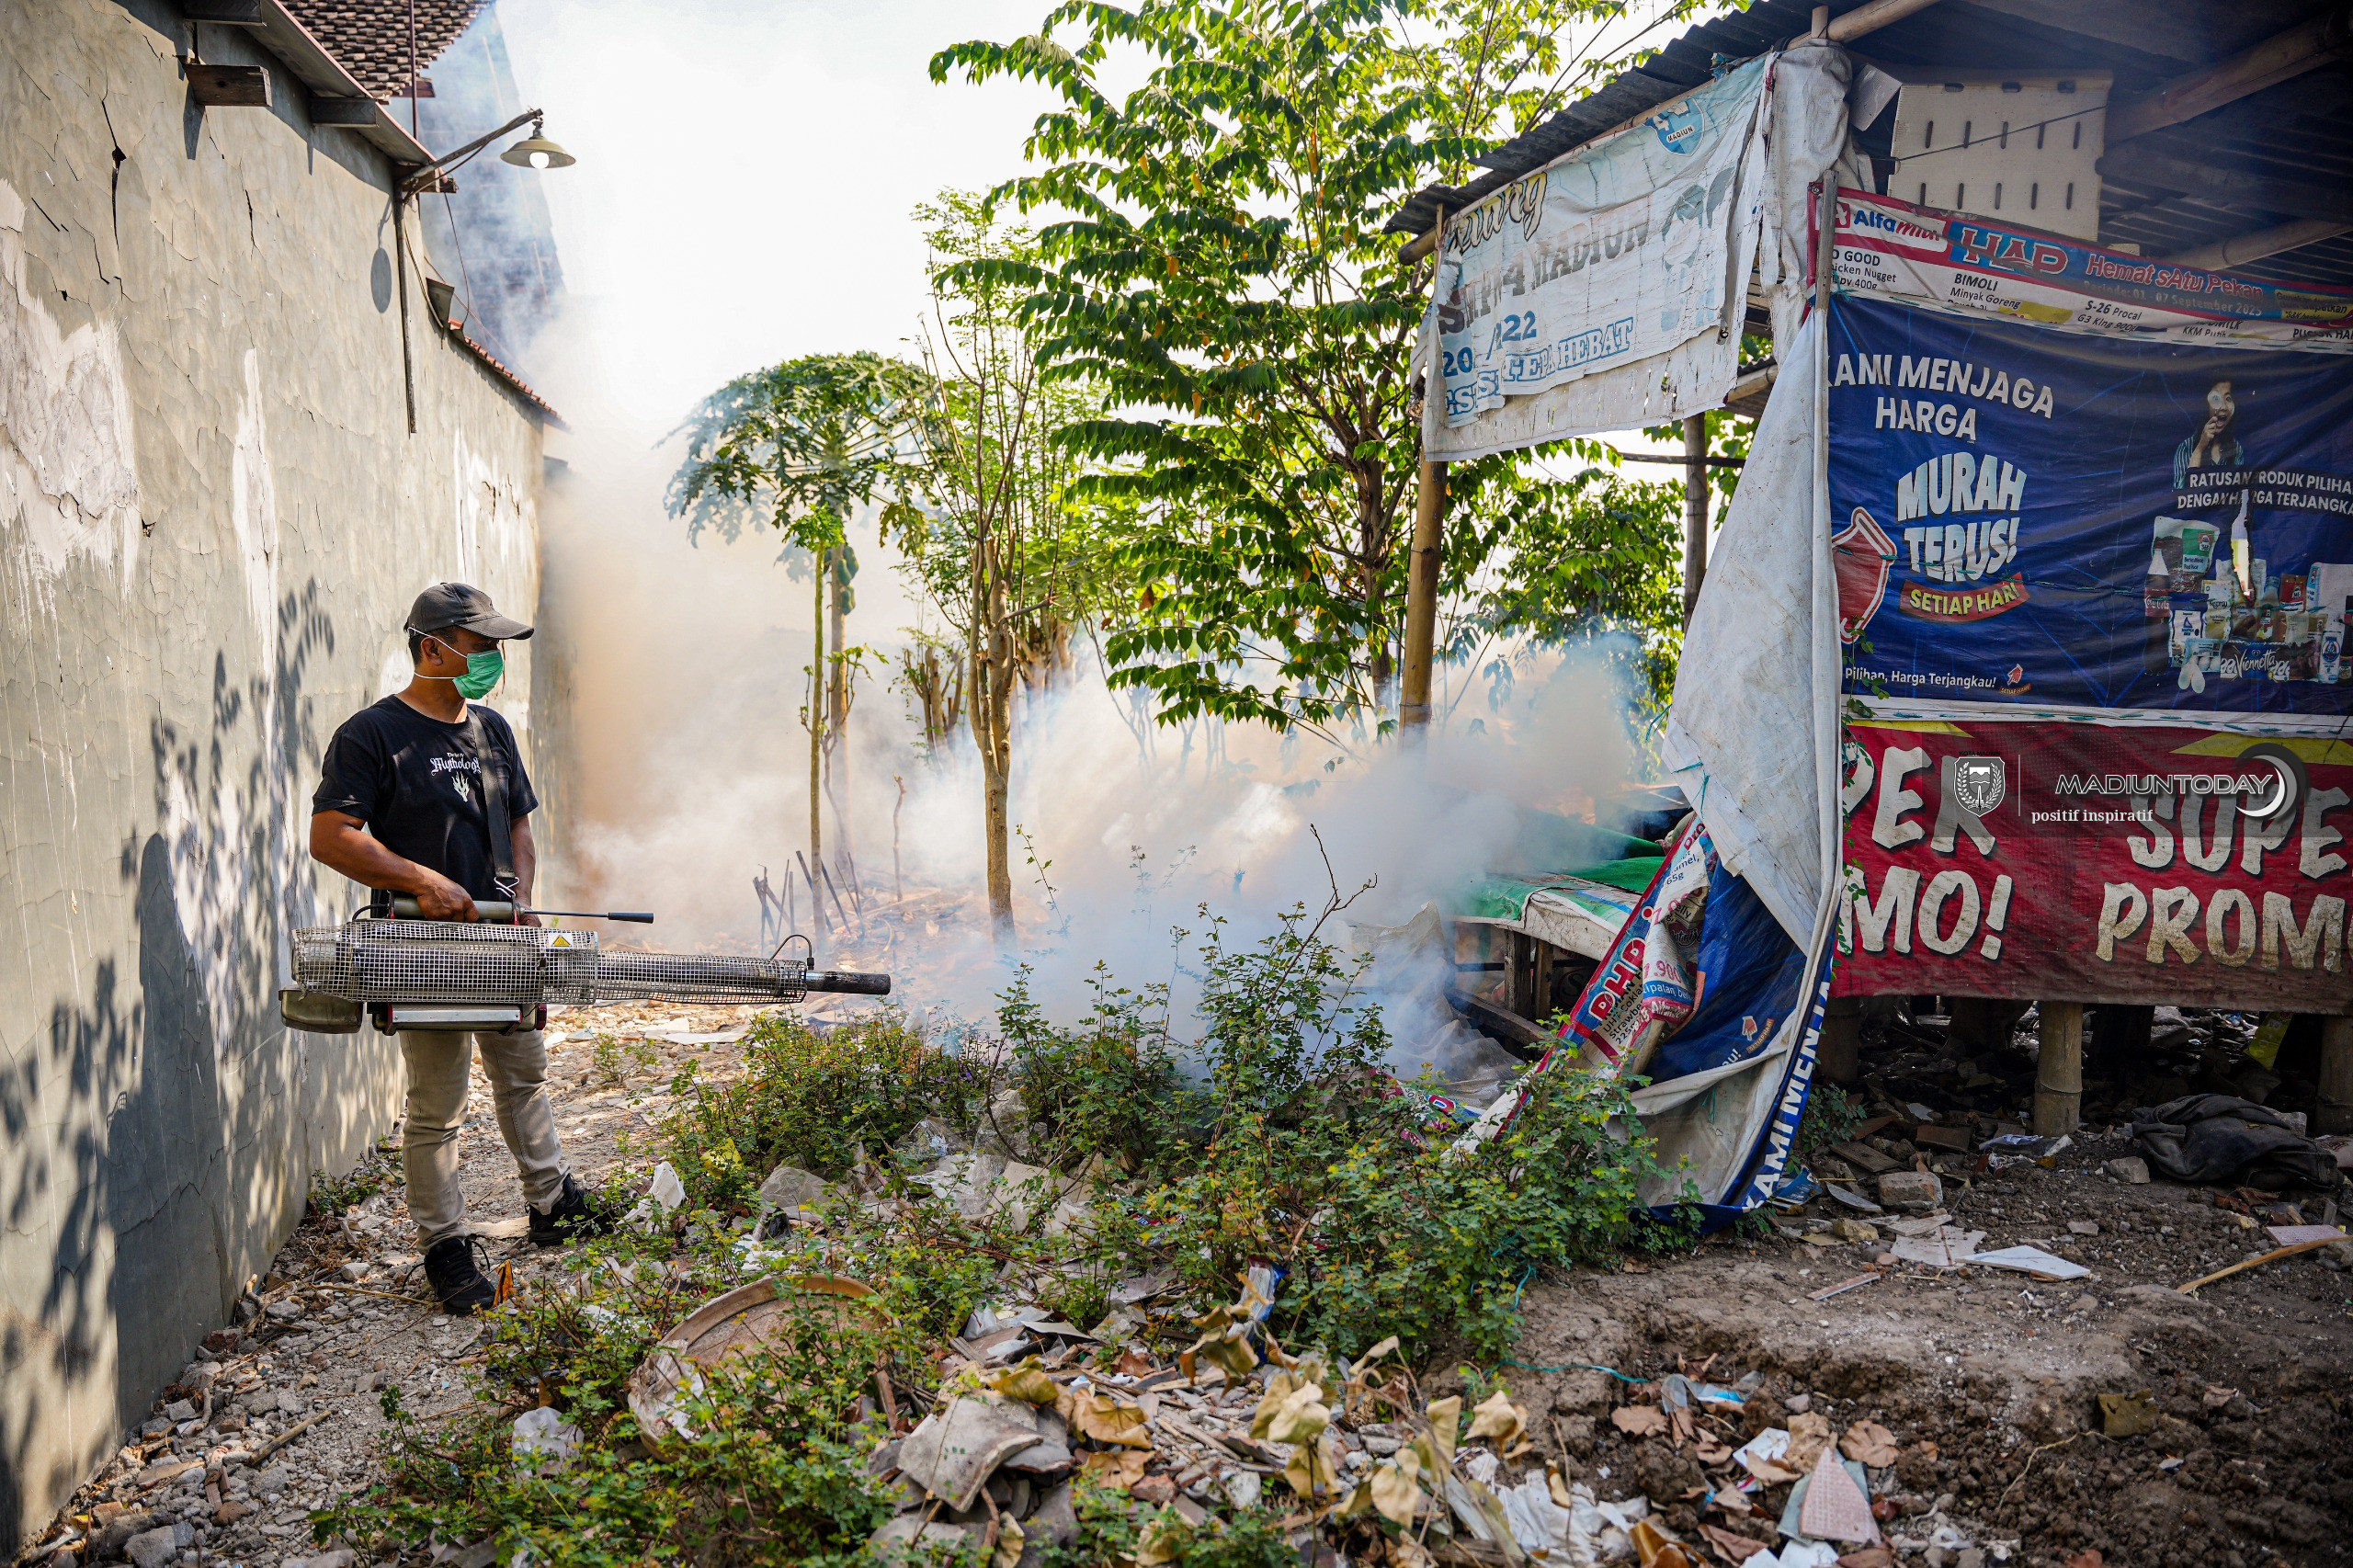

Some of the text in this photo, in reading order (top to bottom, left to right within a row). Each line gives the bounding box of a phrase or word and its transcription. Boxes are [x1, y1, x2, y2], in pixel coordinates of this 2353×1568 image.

[1667, 126, 1693, 142] MADIUN
[1833, 249, 1881, 267] O GOOD
[1961, 227, 2069, 274] HAP
[1864, 267, 1897, 283] Nugget
[1954, 273, 1998, 292] BIMOLI
[2086, 254, 2155, 285] Hemat
[2205, 275, 2265, 302] Pekan
[1950, 287, 2021, 310] Minyak Goreng
[2086, 301, 2143, 321] S-26 Procal
[2182, 326, 2202, 336] KKM
[1557, 316, 1634, 371] HEBAT
[1897, 355, 2054, 419] MENJAGA
[1876, 396, 1976, 441] HARGA
[1897, 451, 2028, 522] MURAH
[2189, 472, 2252, 488] RATUSAN
[2177, 493, 2227, 509] DENGAN
[2229, 491, 2273, 505] HGA
[1904, 517, 2020, 583] TERUS!
[1910, 582, 2021, 615] SETIAP HARI
[2234, 649, 2278, 678] Viennetta
[1845, 667, 1997, 689] Pilihan, Harga Terjangkau!
[1666, 872, 1684, 885] 65g
[2095, 881, 2353, 973] PROM
